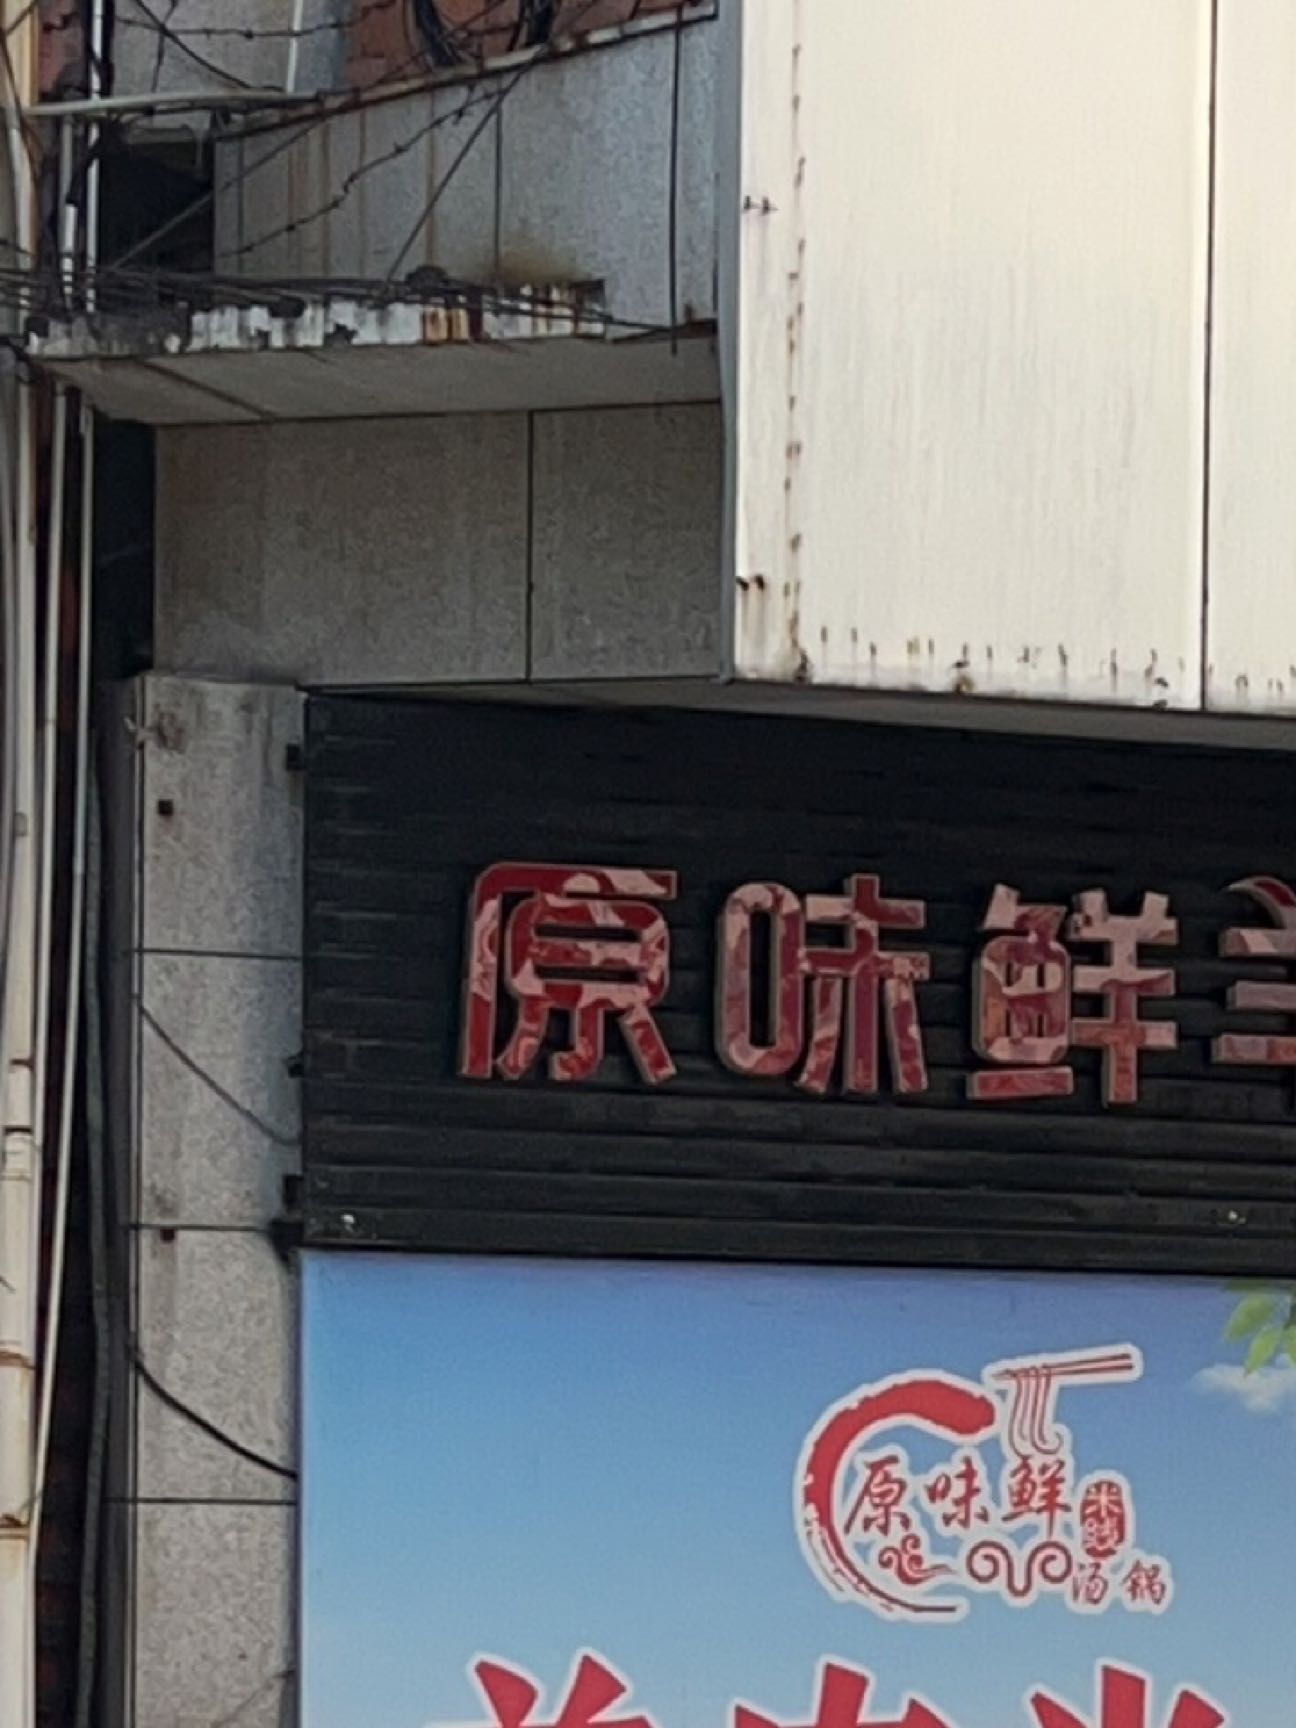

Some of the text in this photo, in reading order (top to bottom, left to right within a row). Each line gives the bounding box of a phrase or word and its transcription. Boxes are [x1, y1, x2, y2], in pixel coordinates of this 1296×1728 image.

[843, 1454, 1073, 1538] 原味鲜
[1071, 1559, 1168, 1606] 汤锅
